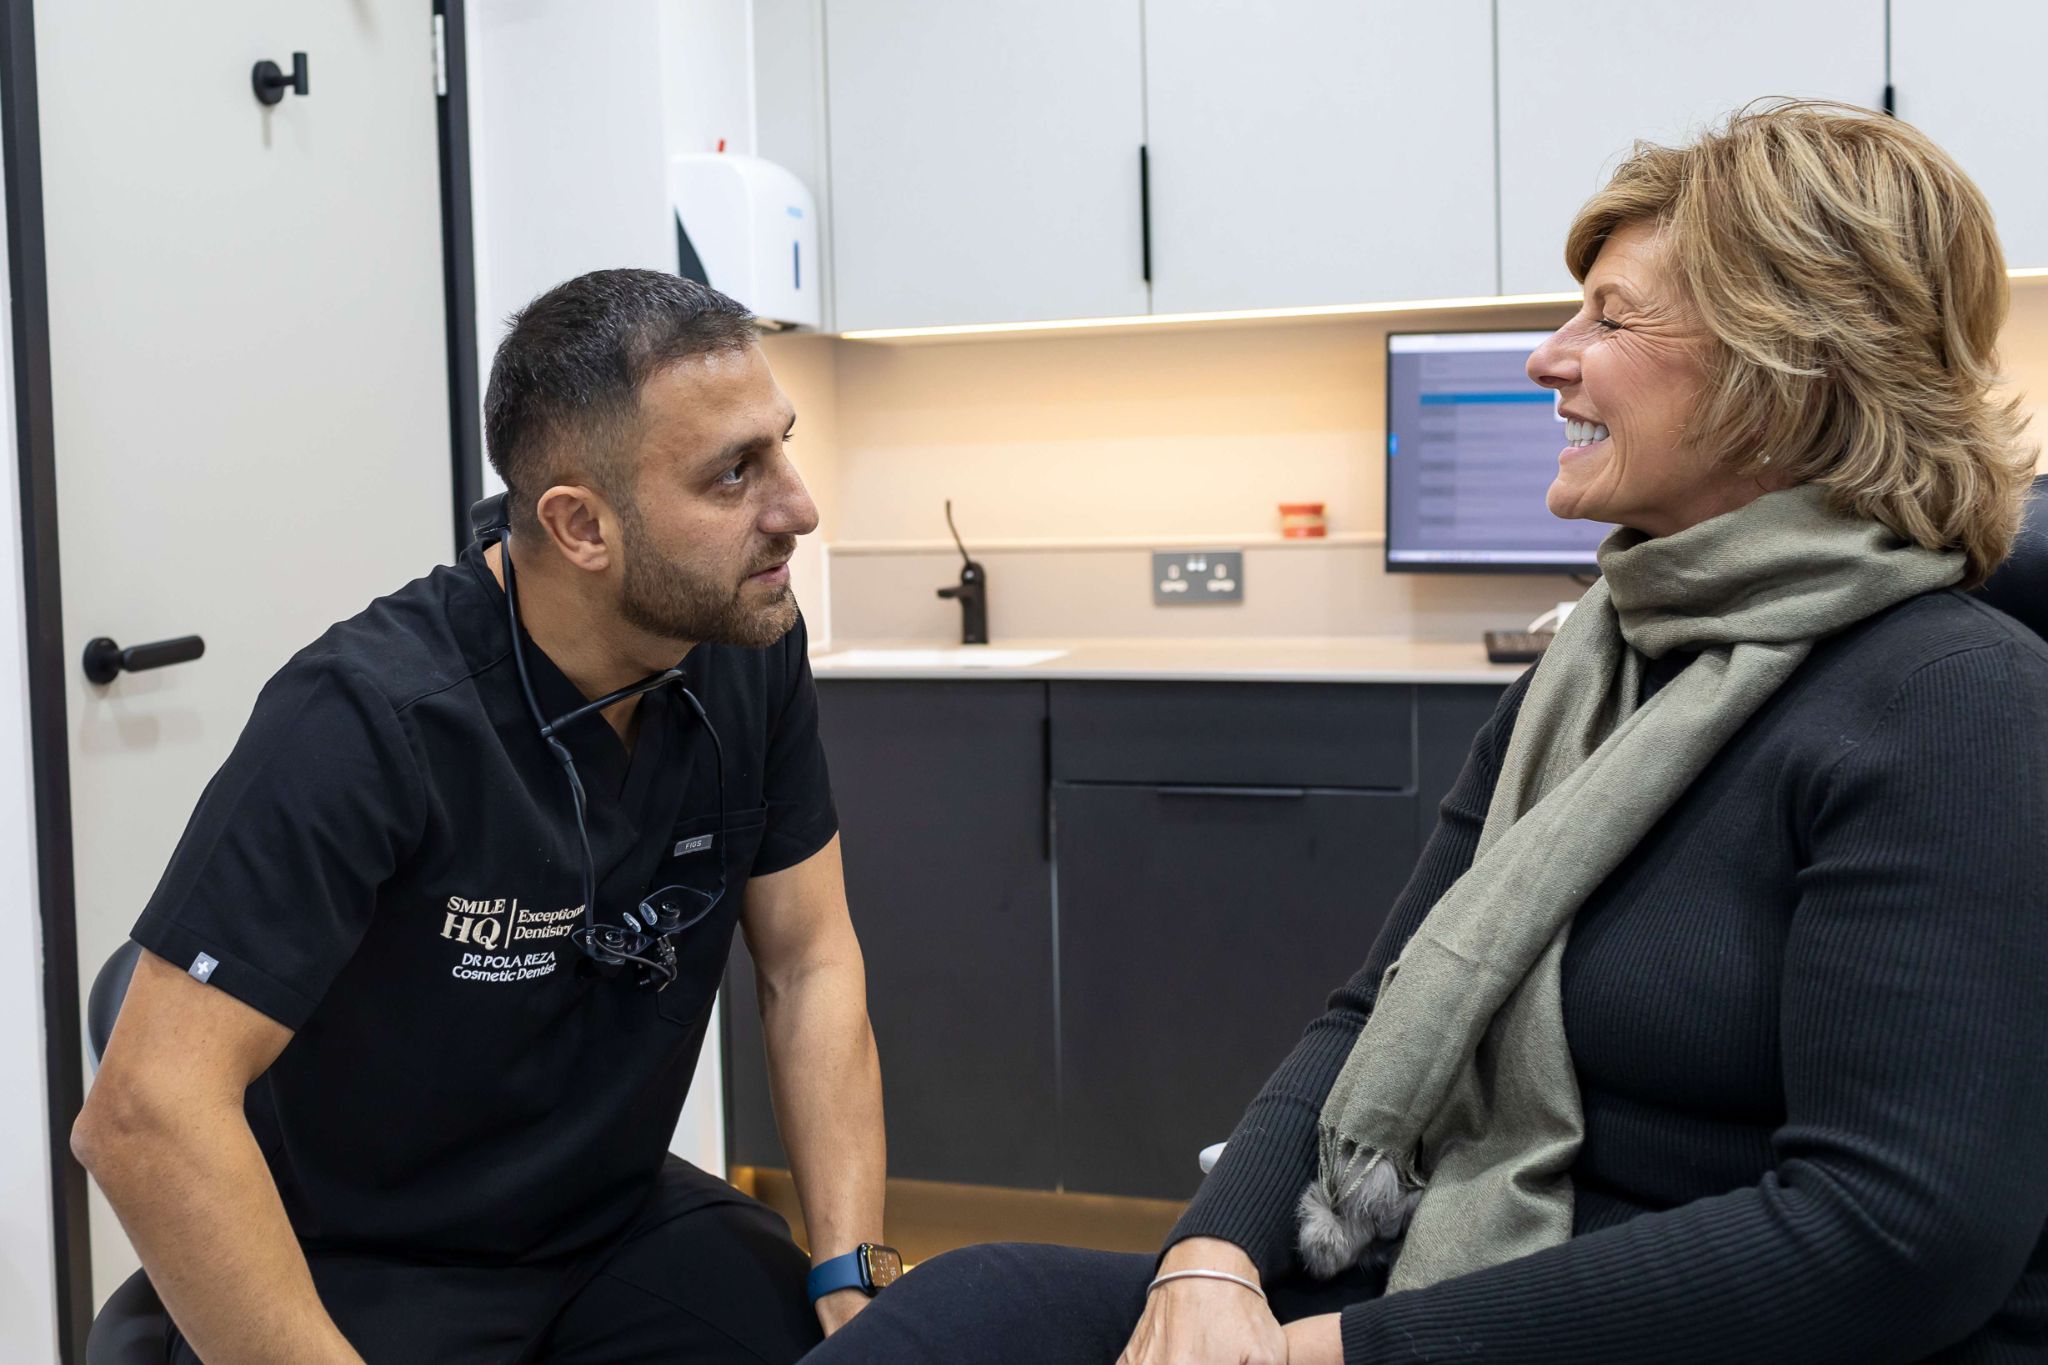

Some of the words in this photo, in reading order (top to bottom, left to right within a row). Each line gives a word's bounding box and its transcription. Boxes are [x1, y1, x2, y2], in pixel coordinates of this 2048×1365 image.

[447, 896, 506, 916] SMILE
[517, 904, 586, 924] Exceptiona
[440, 912, 501, 951] HQ
[513, 924, 574, 940] Dentistry
[462, 953, 482, 967] DR
[483, 955, 522, 969] POLA
[523, 951, 556, 966] REZA
[452, 966, 517, 983] Cosmetic
[517, 963, 557, 981] Dentist
